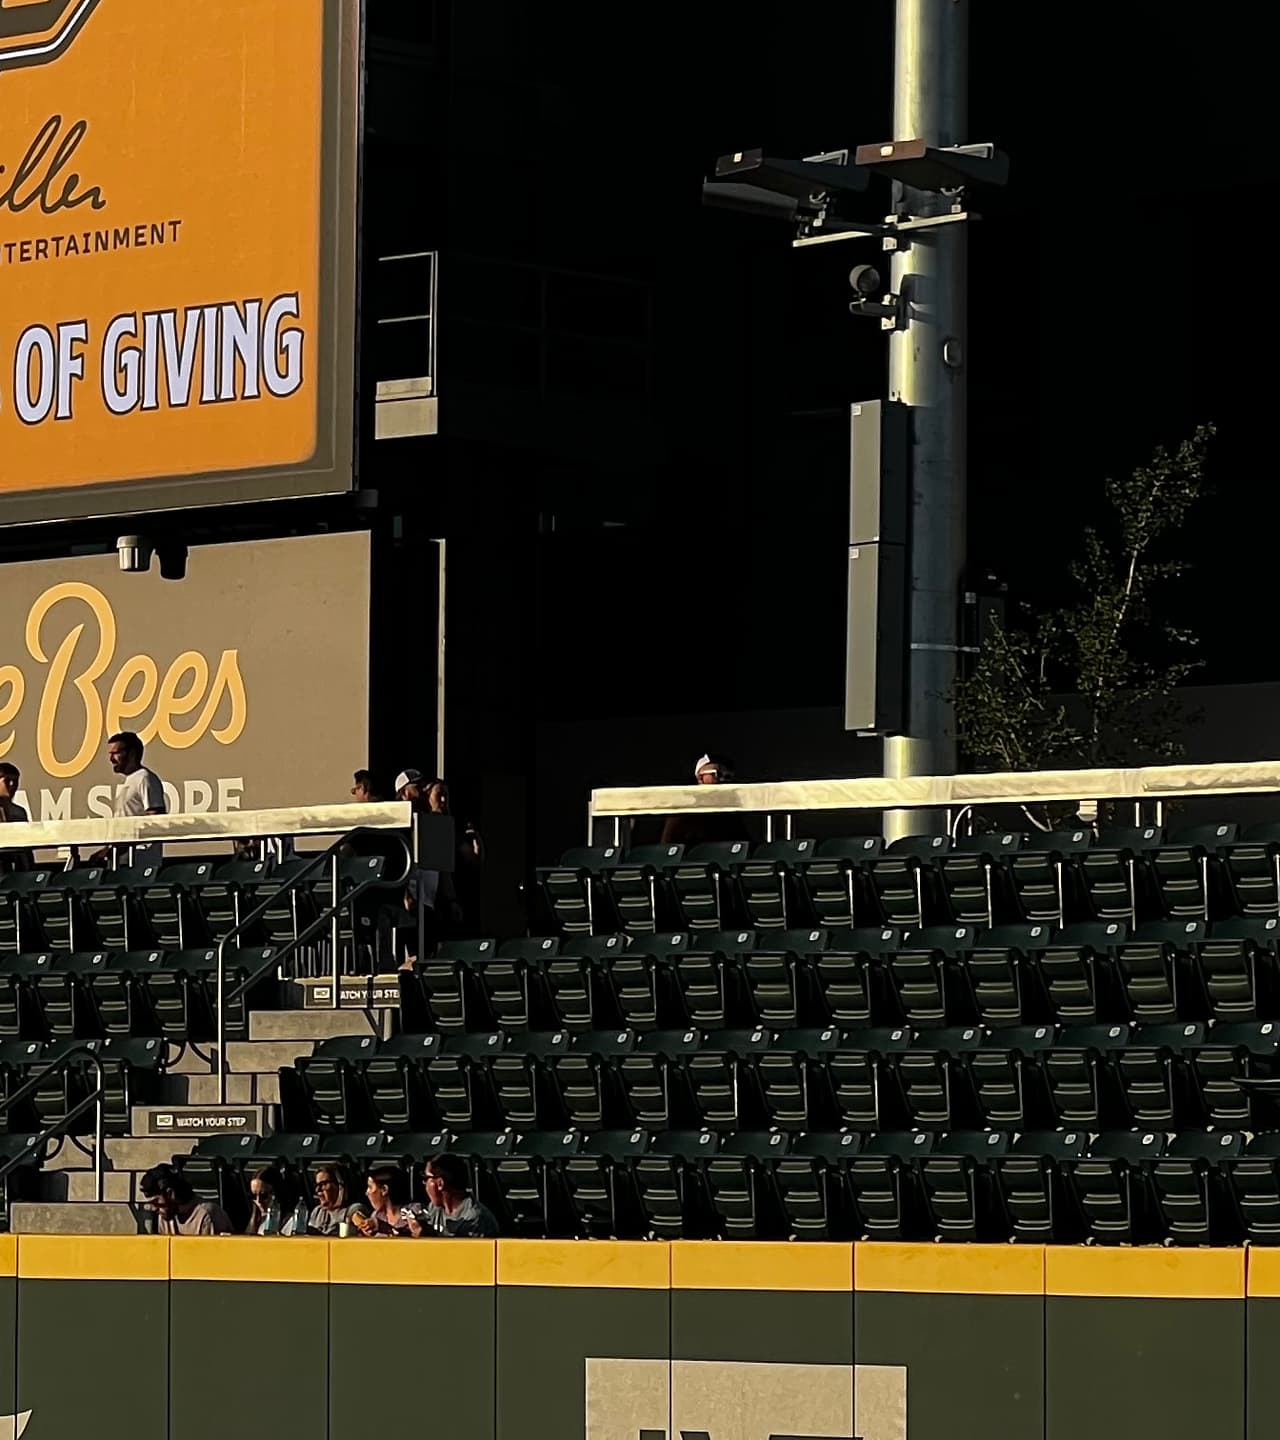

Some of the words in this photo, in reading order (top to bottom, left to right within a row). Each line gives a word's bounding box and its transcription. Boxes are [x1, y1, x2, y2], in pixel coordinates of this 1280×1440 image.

[15, 322, 89, 425] OF
[100, 290, 306, 415] GIVING
[24, 581, 248, 779] Bees
[86, 777, 245, 820] SORE
[340, 990, 360, 1000] ATCH
[361, 989, 383, 1000] YUR
[176, 1117, 204, 1127] WATCH
[205, 1117, 226, 1127] YOUR
[227, 1117, 246, 1127] STEP
